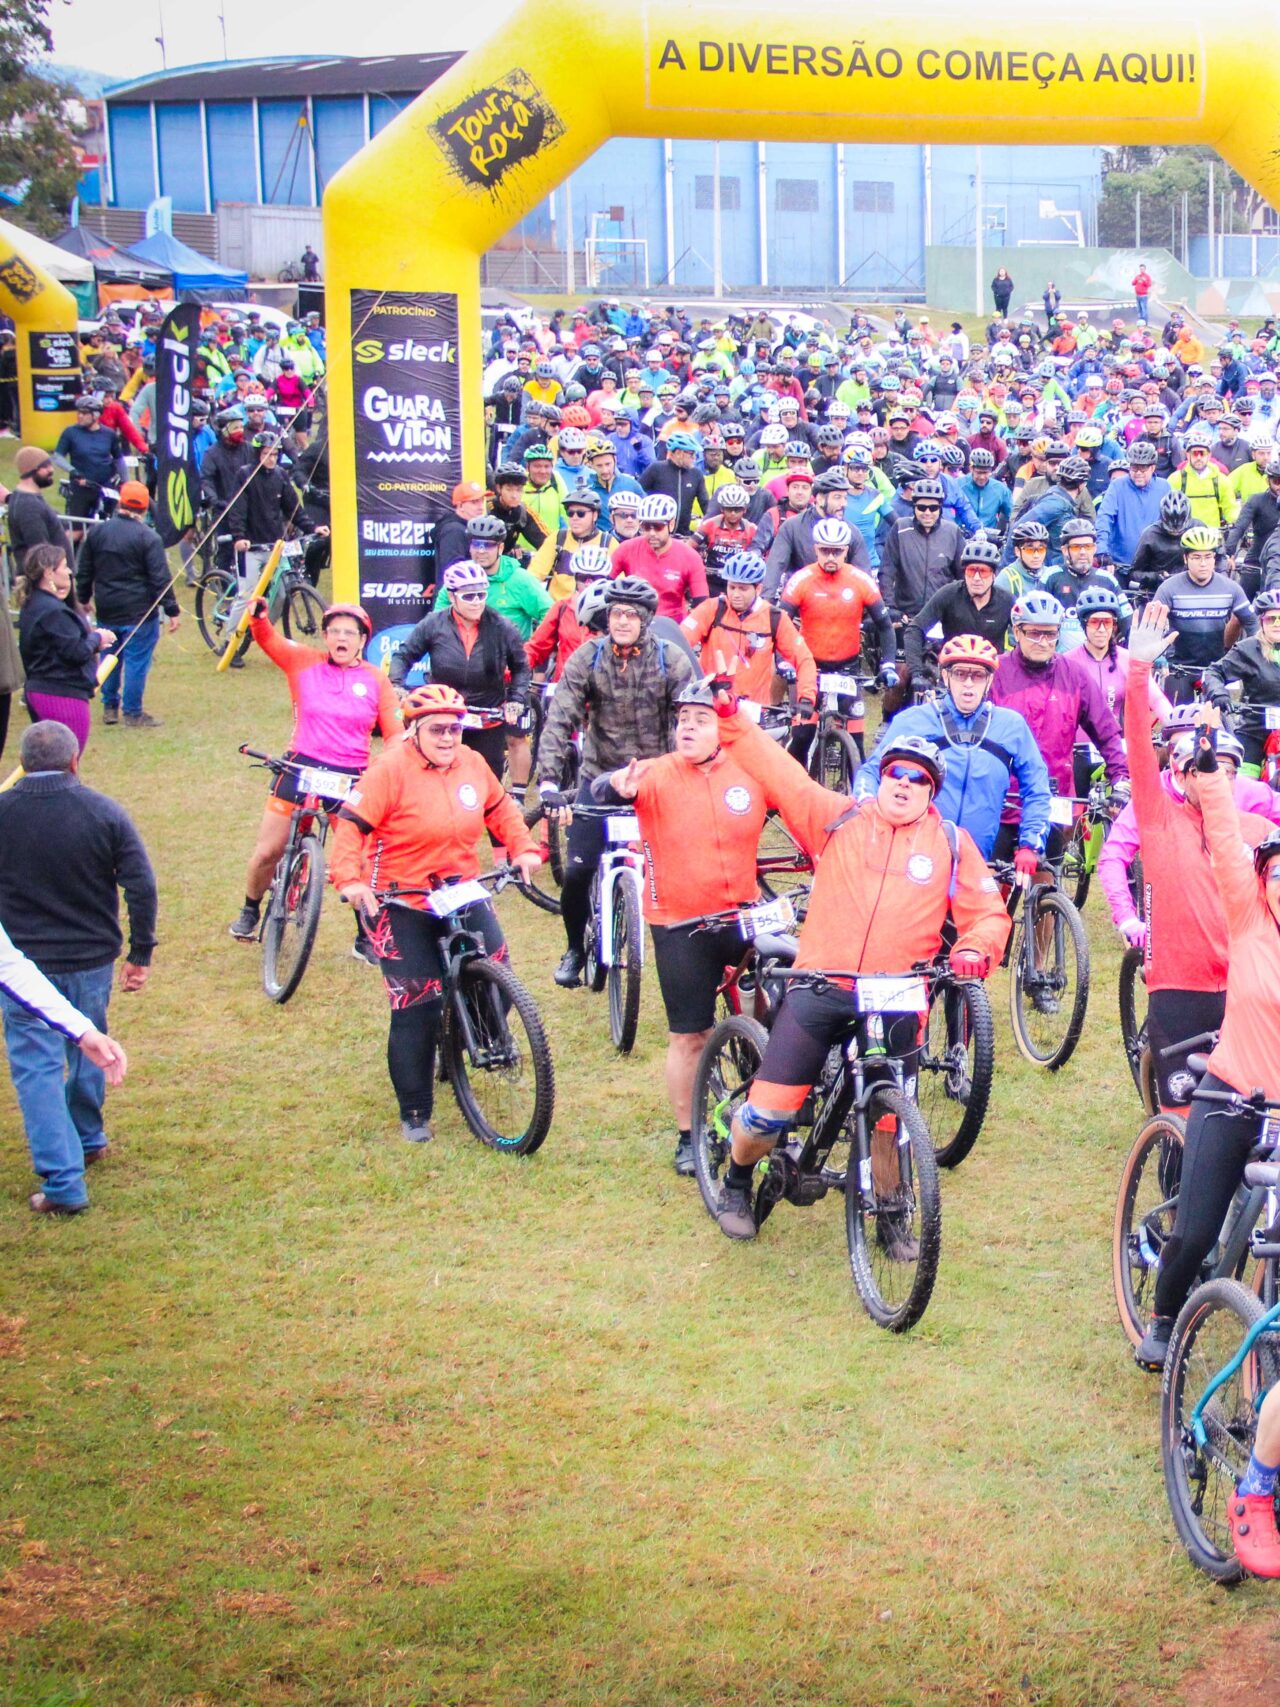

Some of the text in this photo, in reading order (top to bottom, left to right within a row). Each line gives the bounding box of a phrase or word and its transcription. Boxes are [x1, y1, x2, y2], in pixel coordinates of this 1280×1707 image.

[658, 39, 1195, 89] A DIVERSÃO COMEÇA AQUI!
[373, 305, 437, 317] PATROCÍNIO
[388, 339, 457, 363] sleck
[363, 386, 446, 421] GUARA
